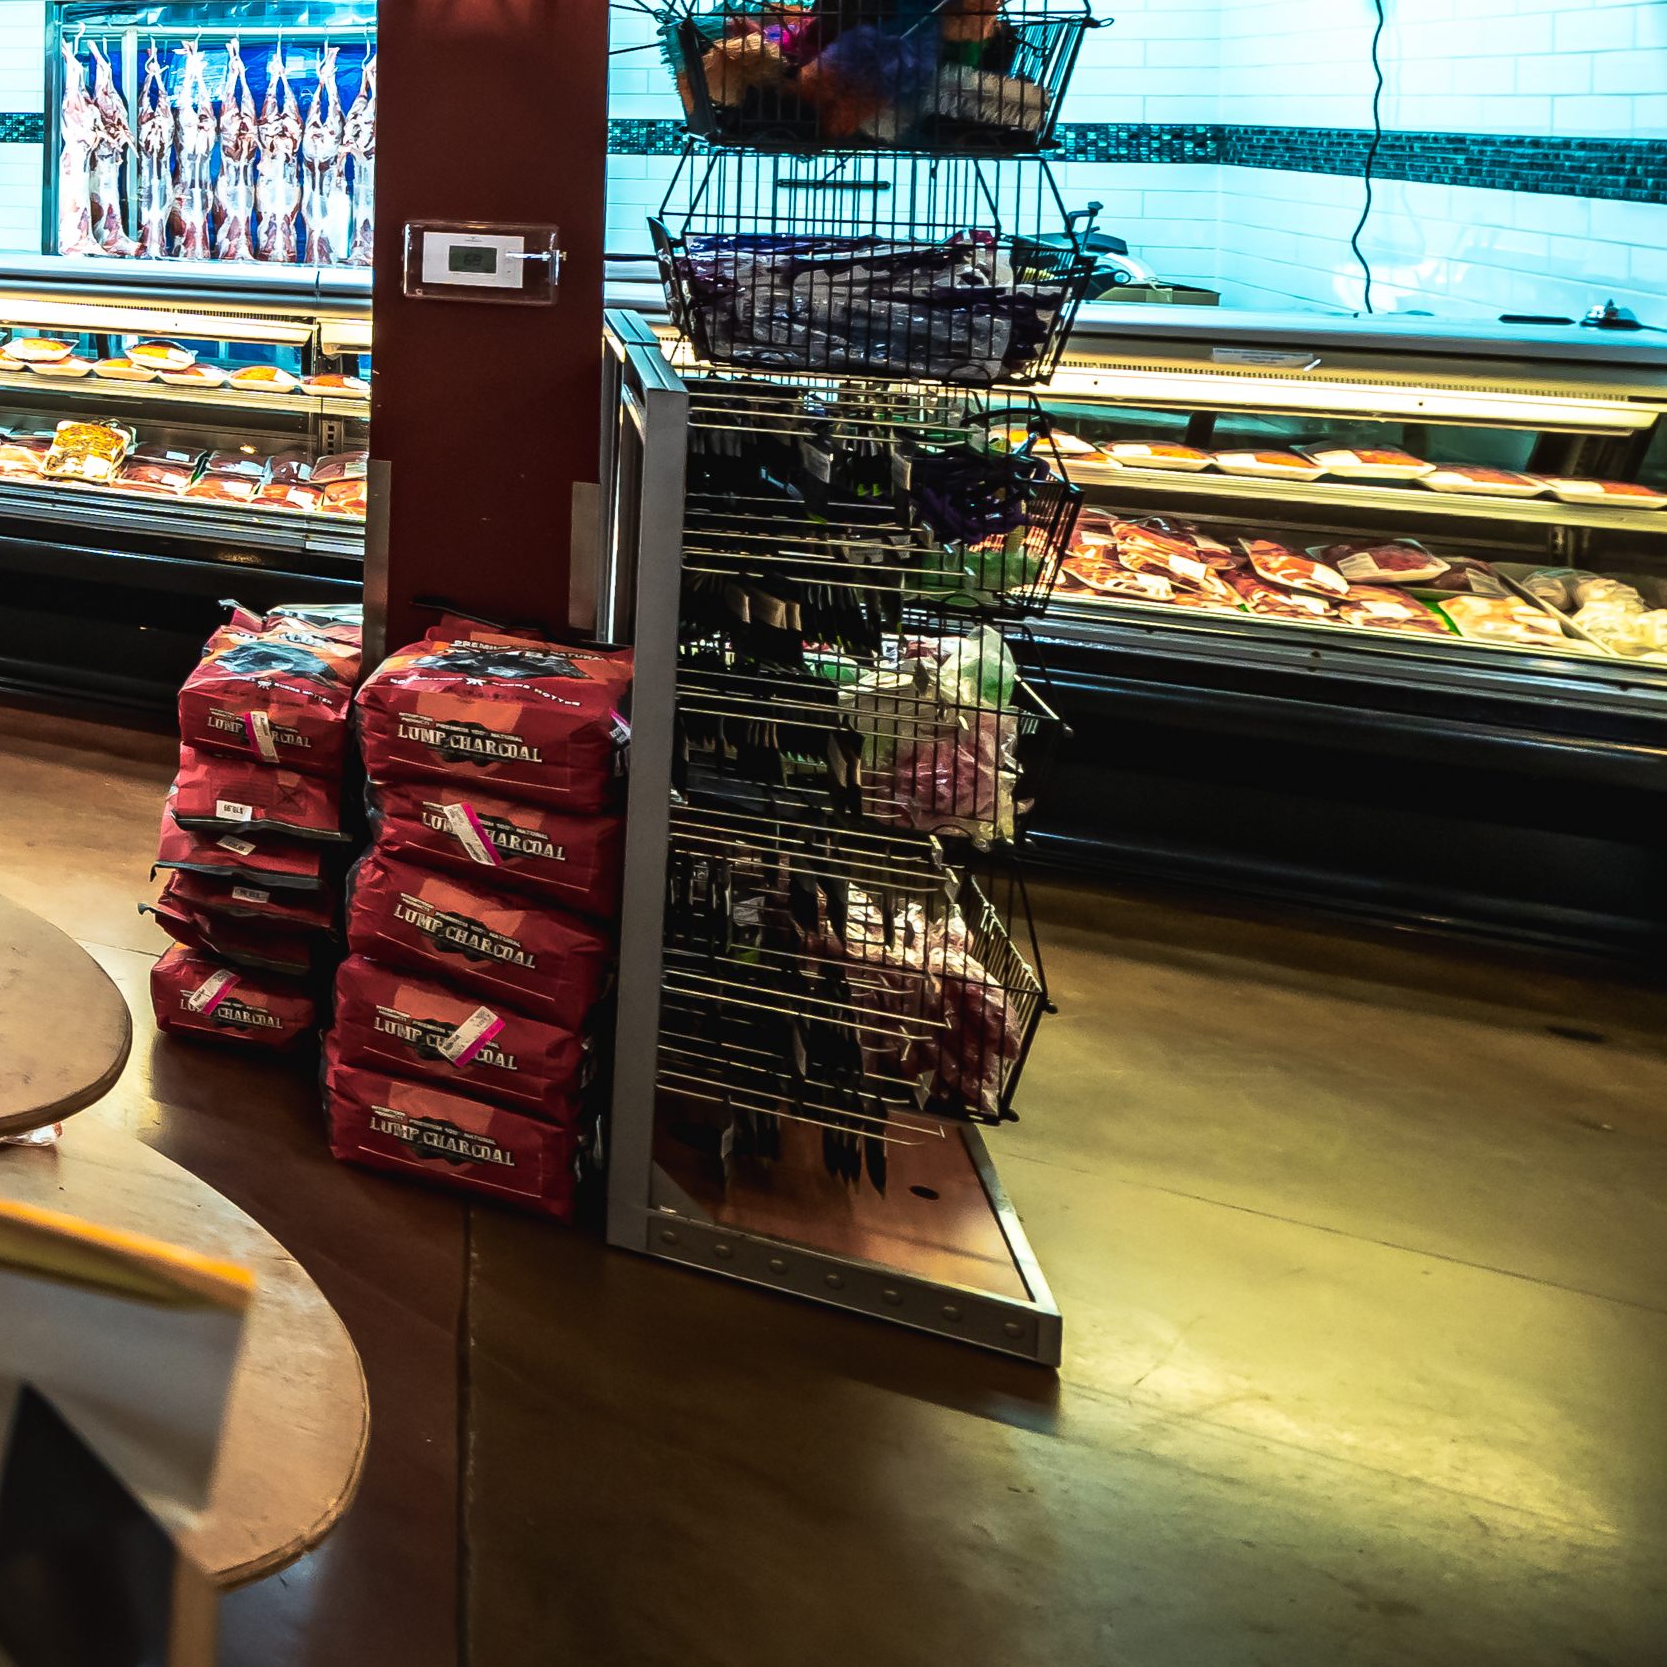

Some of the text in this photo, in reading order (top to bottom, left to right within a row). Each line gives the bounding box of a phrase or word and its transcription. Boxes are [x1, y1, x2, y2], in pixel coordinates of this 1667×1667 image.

[207, 717, 243, 733] LUMP
[398, 724, 542, 762] LUMP CHARCOAL
[487, 828, 565, 861] HARCOAL
[394, 904, 536, 969] LUMP CHARCOAL
[218, 1007, 283, 1029] CHARCOAL
[374, 1017, 423, 1041] LUMP
[370, 1117, 515, 1166] LUMP CHARCOAL
